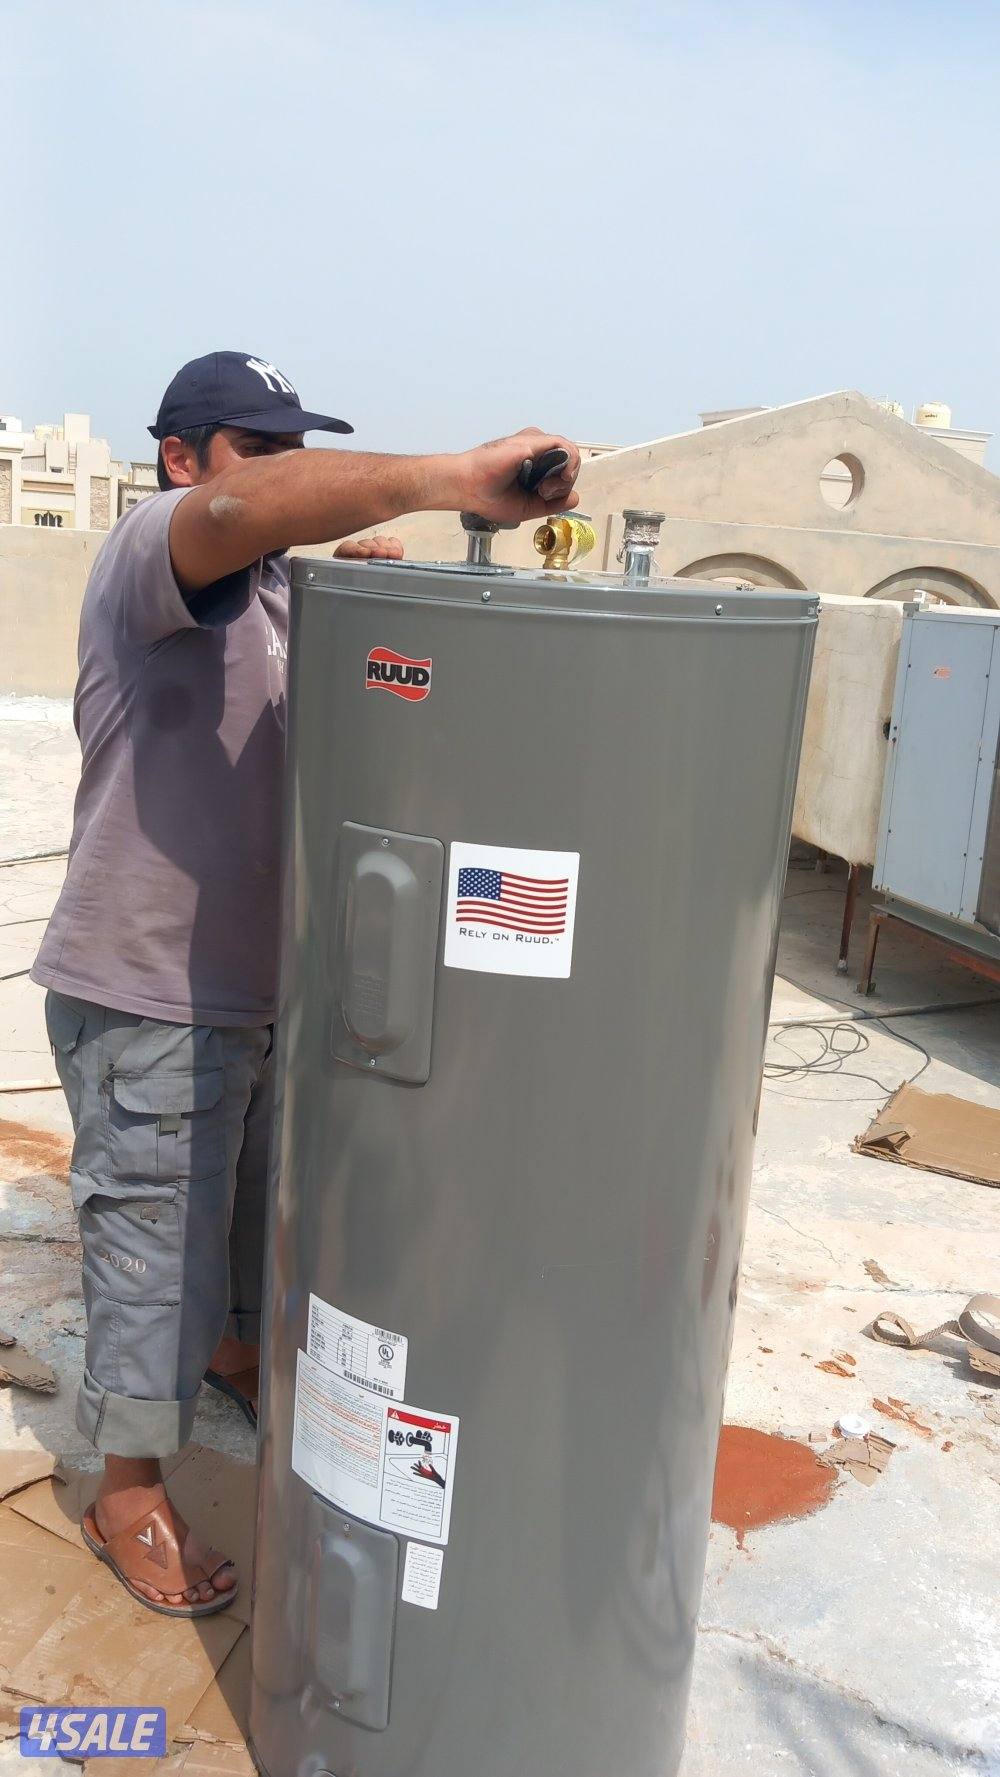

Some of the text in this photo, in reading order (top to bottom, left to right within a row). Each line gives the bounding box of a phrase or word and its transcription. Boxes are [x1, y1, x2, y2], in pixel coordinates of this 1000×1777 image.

[367, 661, 430, 687] RUUD
[459, 927, 487, 939] RELY
[492, 932, 509, 941] ON
